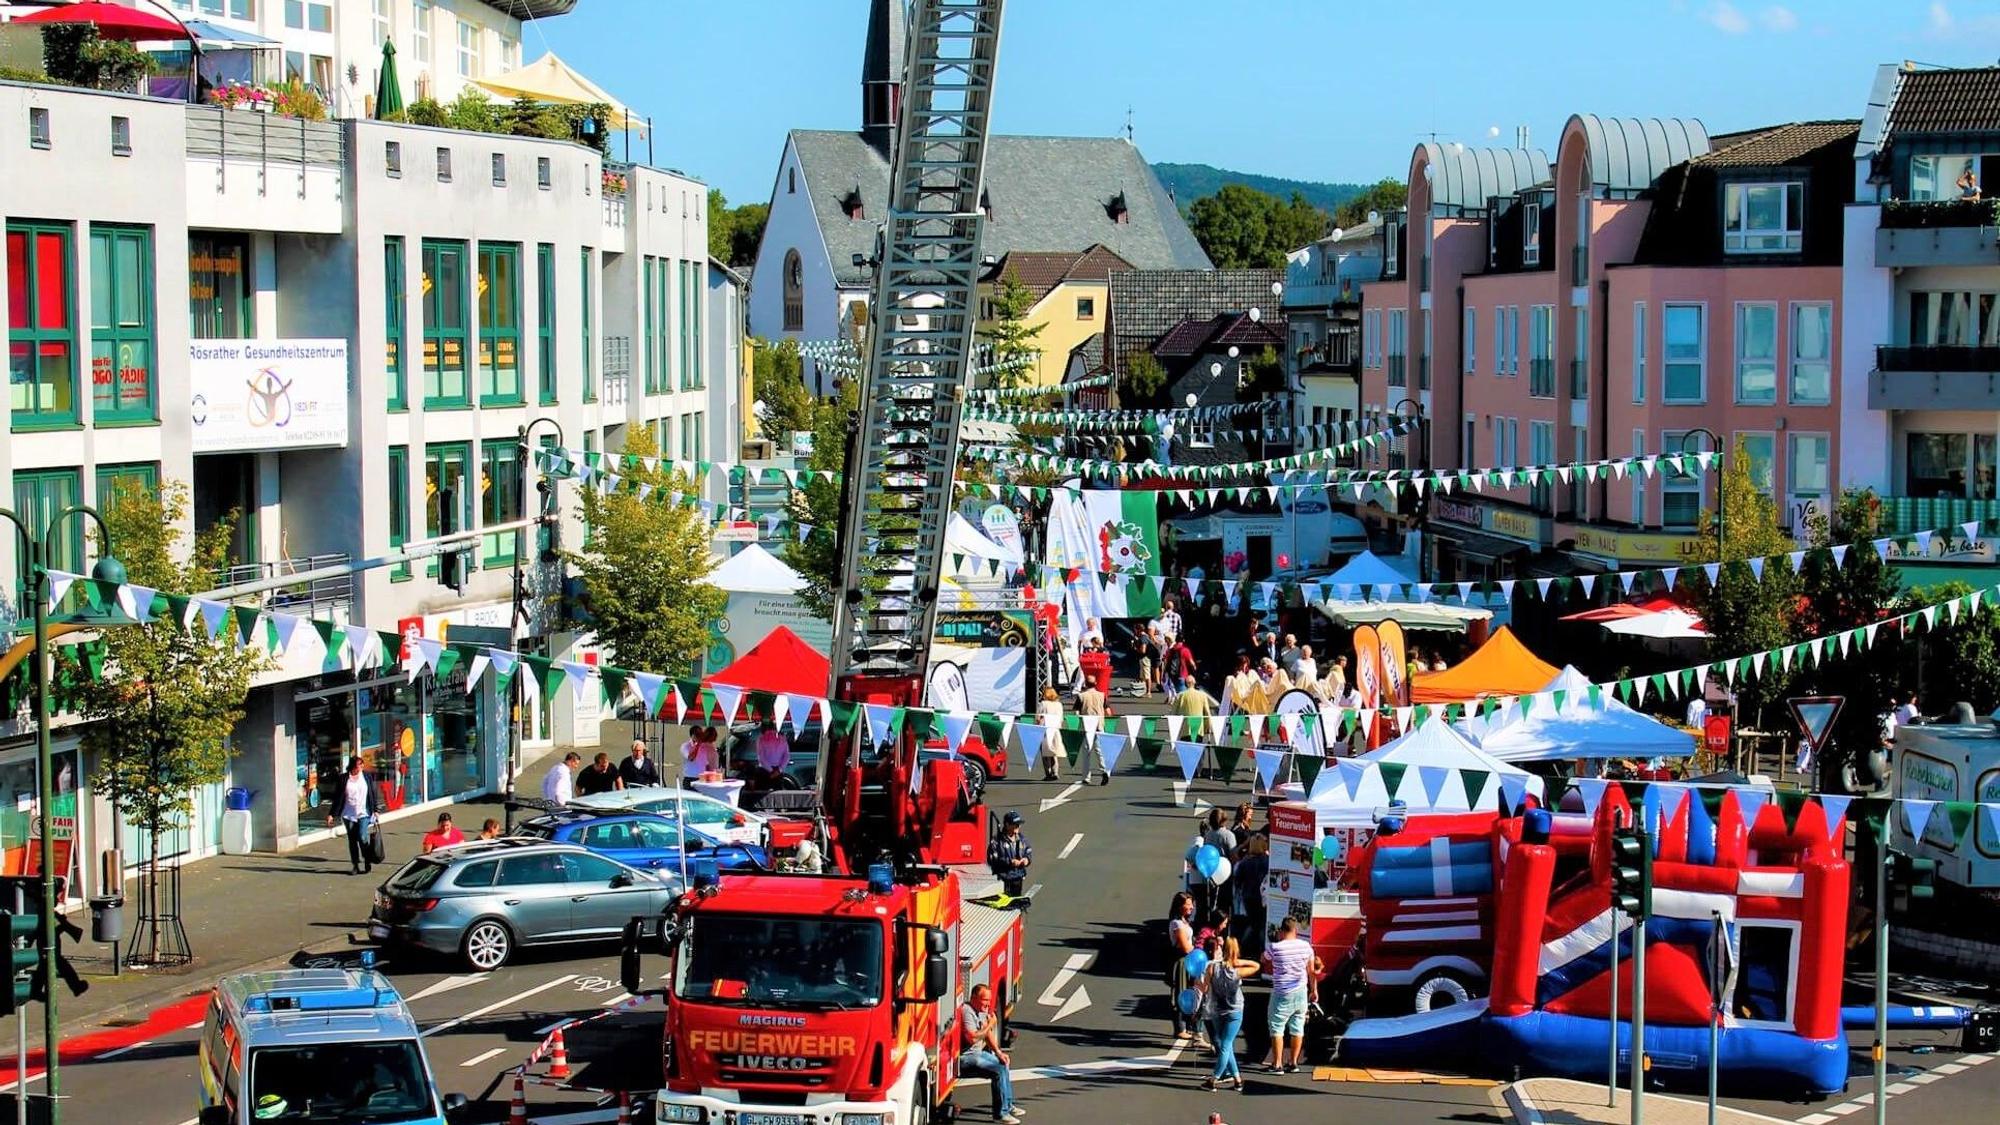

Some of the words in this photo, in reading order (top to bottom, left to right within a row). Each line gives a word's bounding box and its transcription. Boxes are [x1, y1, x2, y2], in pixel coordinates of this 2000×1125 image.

[245, 345, 345, 359] Gesundheitszentrum
[53, 817, 73, 828] FAIR
[1275, 818, 1311, 832] Feuerwehr!
[740, 1014, 806, 1027] MAGIRUS
[689, 1030, 856, 1057] FEUERWEHR
[737, 1055, 806, 1070] IVECO
